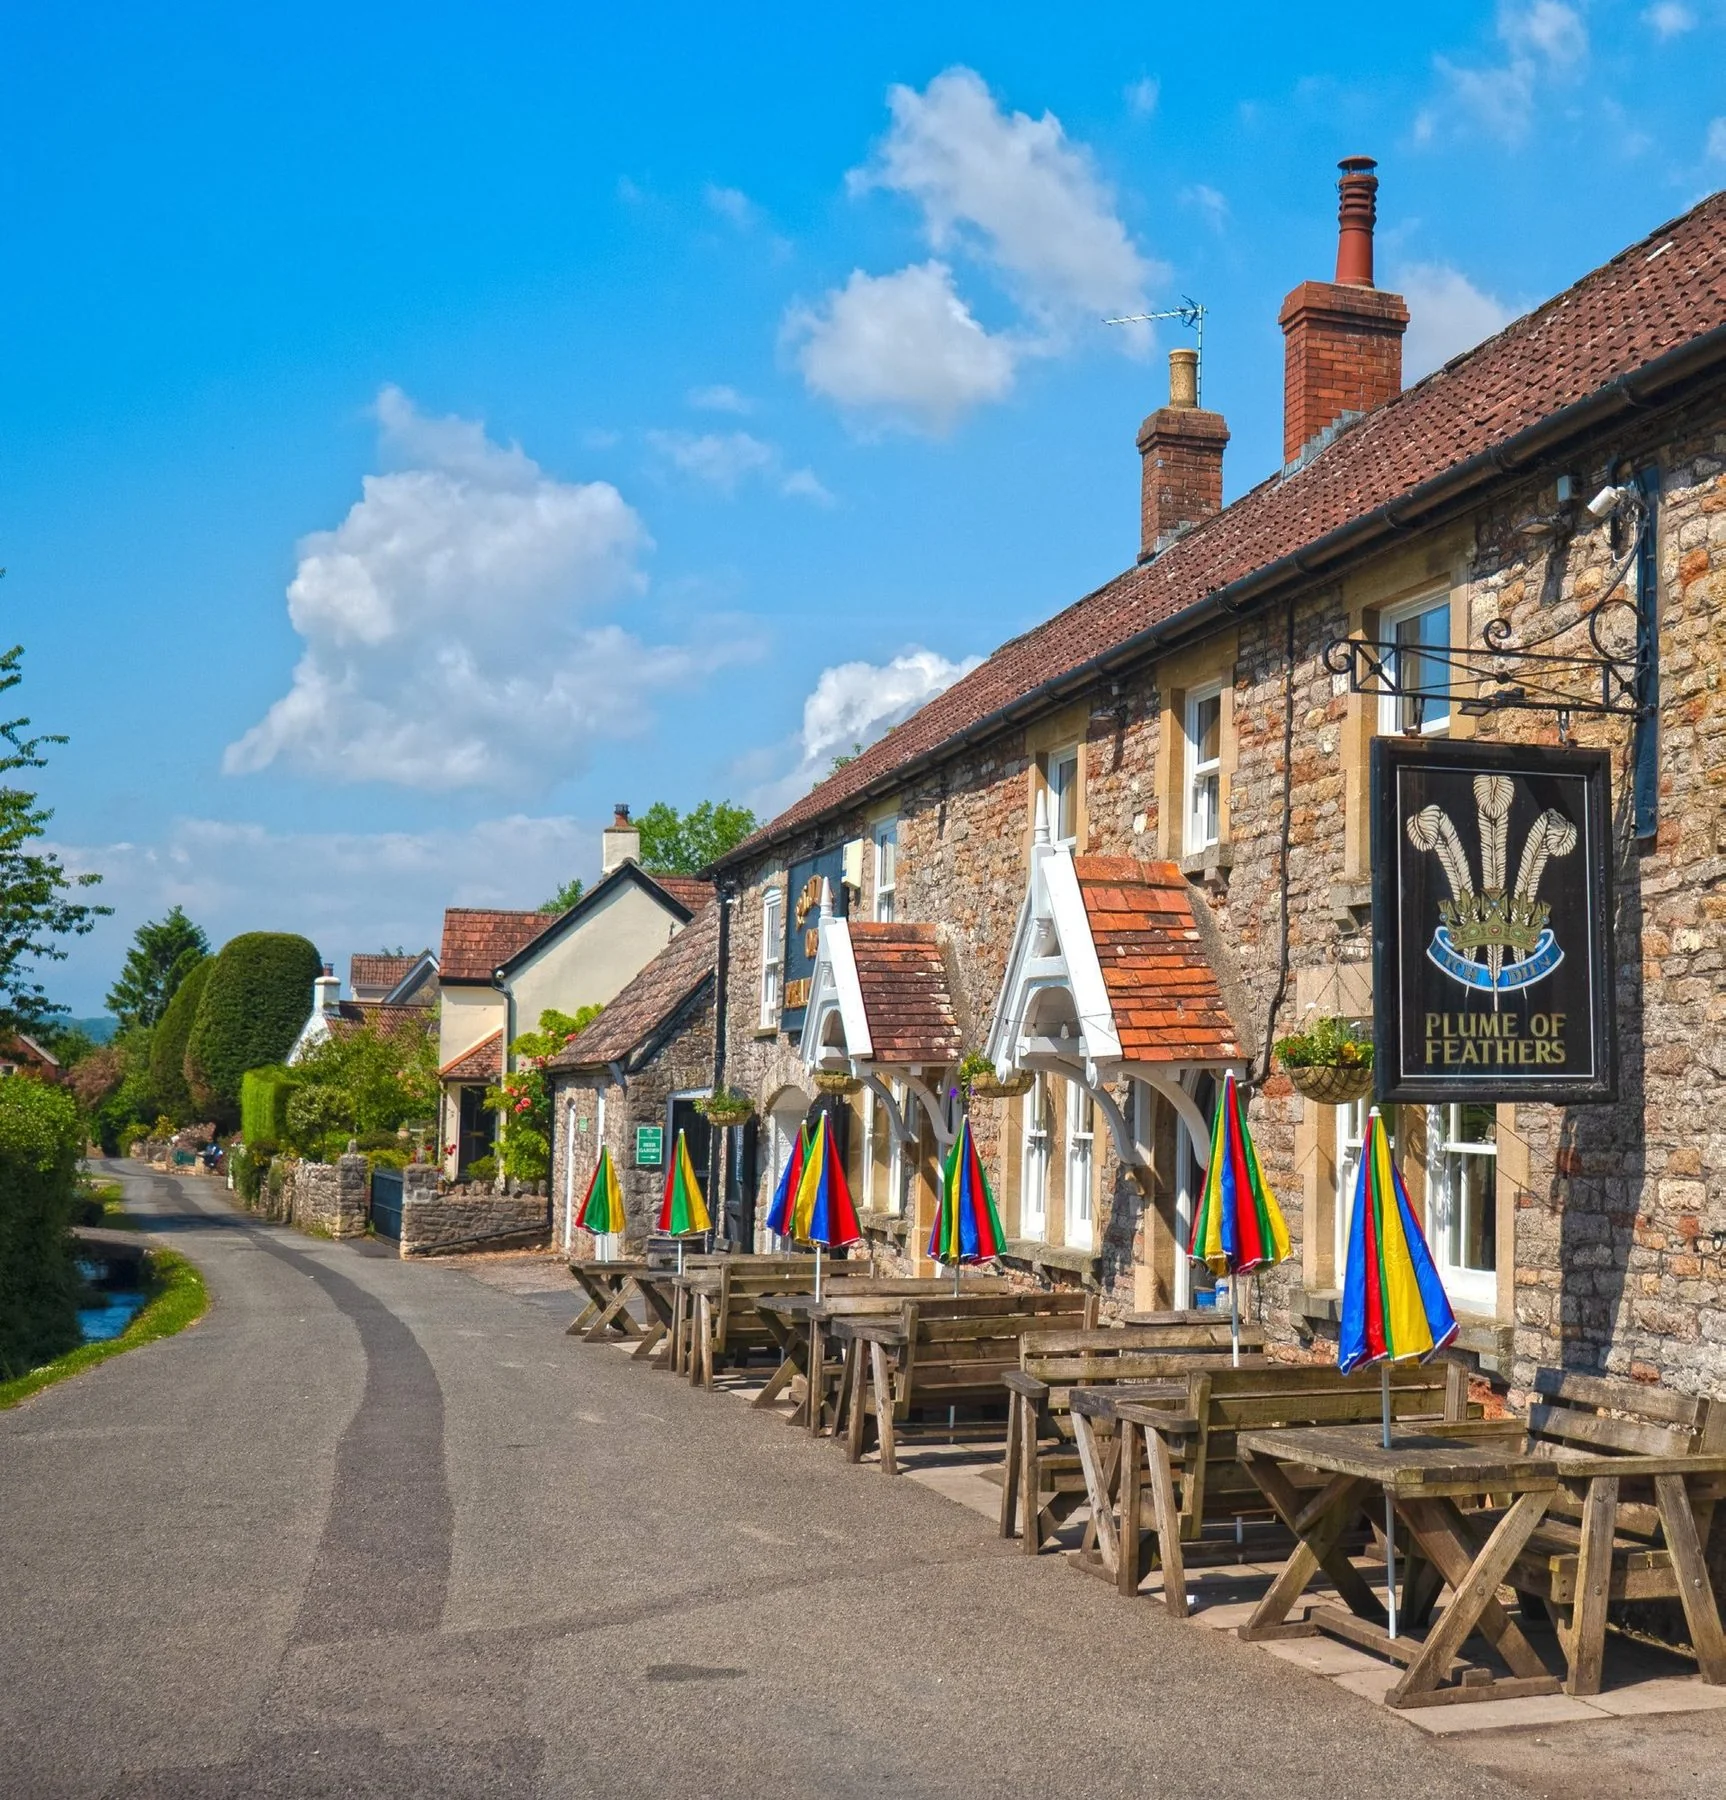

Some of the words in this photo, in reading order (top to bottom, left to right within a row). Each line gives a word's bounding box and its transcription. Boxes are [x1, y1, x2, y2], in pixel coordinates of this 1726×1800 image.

[1425, 1012, 1518, 1037] PLUME
[1530, 1012, 1568, 1038] OF
[1425, 1039, 1566, 1064] FEATHERS
